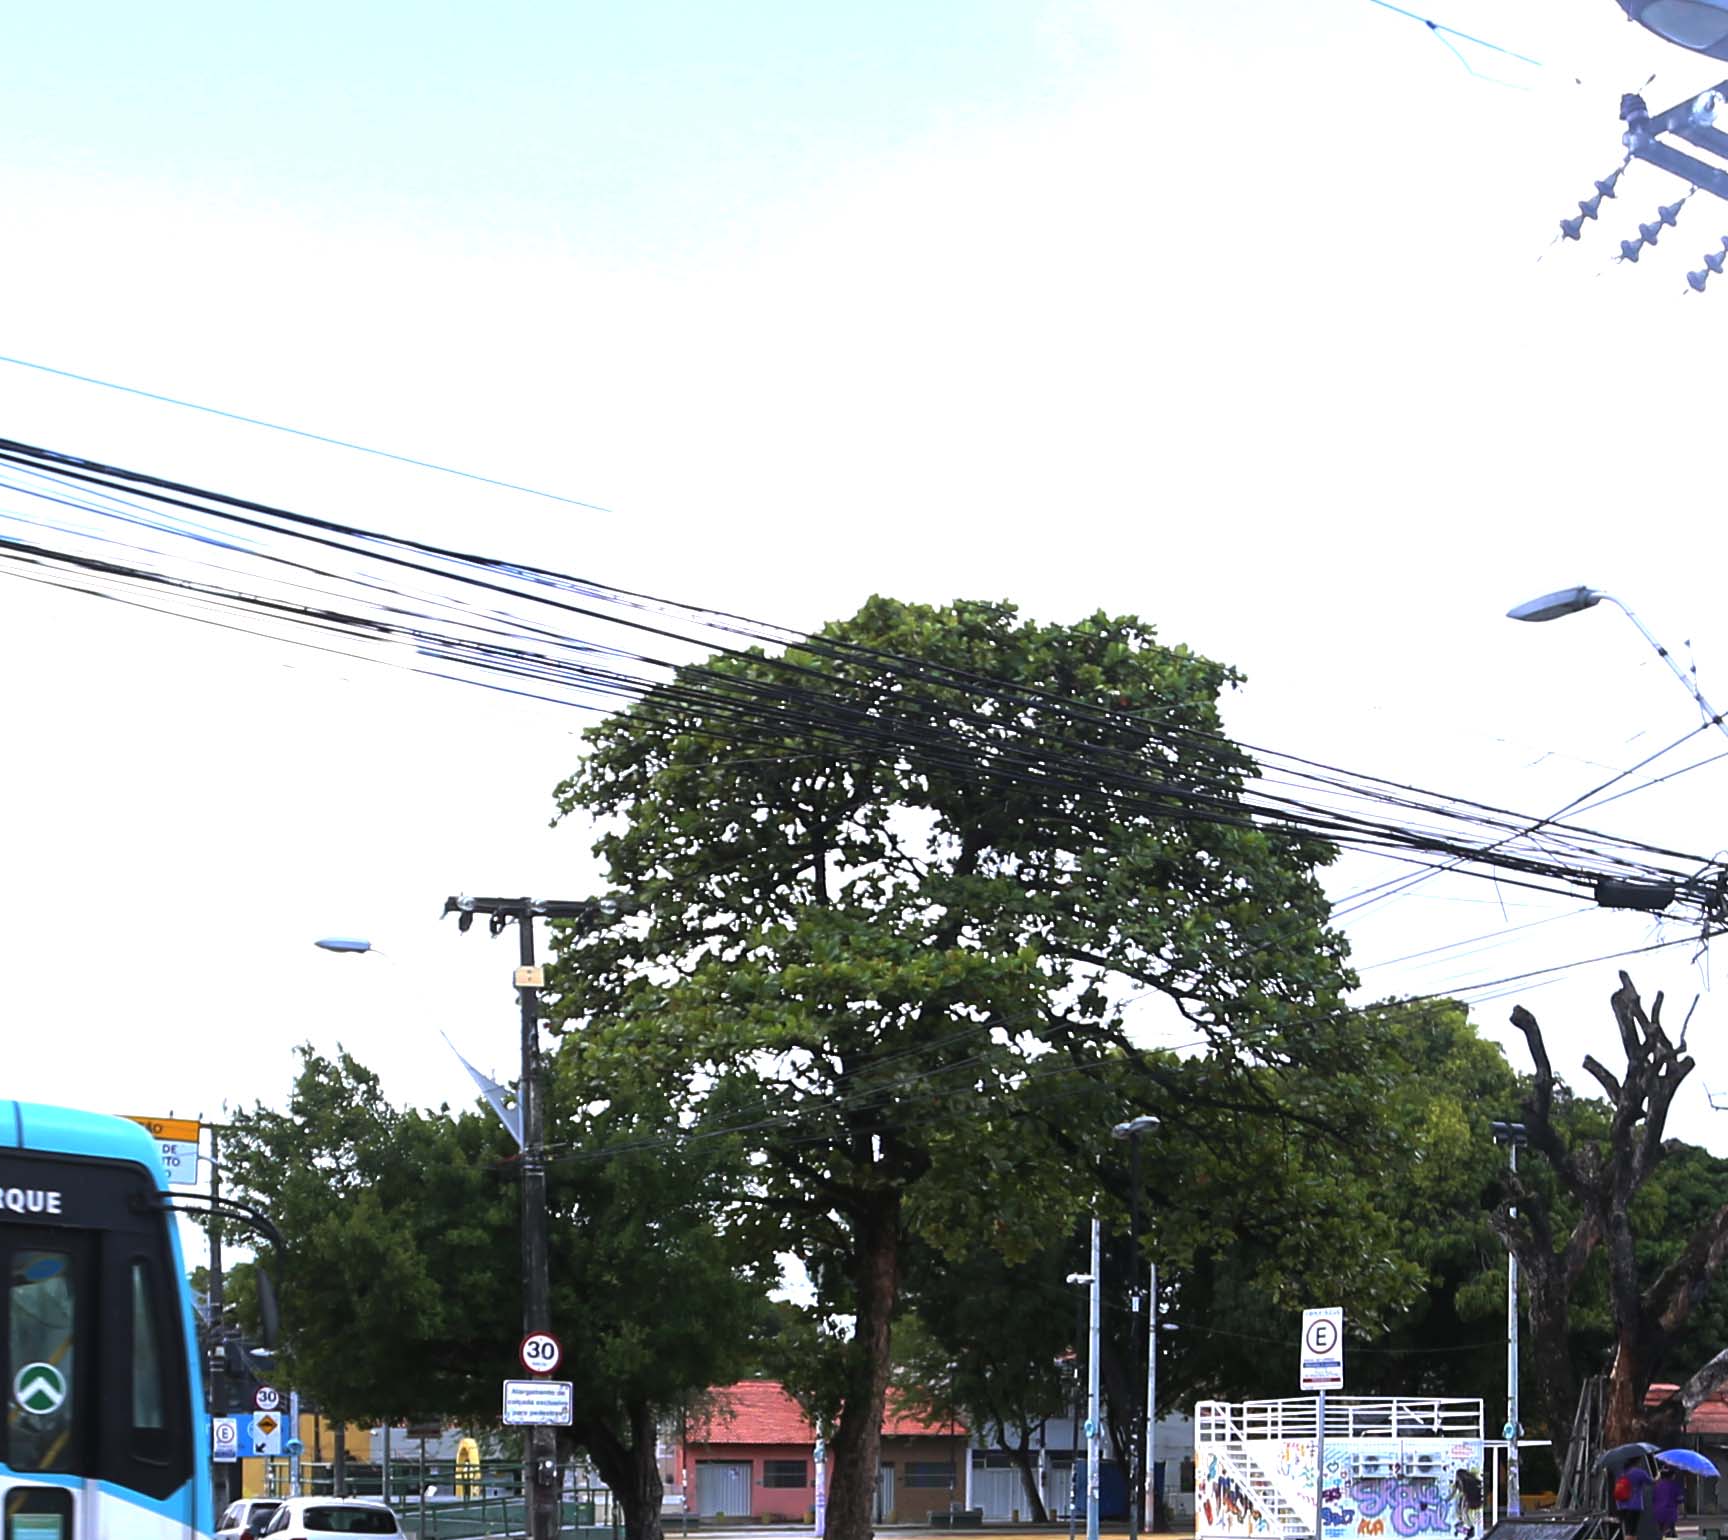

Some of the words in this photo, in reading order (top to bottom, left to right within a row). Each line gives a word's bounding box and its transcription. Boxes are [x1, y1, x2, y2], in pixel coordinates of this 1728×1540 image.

[1316, 1327, 1327, 1346] E
[526, 1340, 555, 1360] 30
[258, 1391, 277, 1402] 30
[221, 1427, 230, 1440] E
